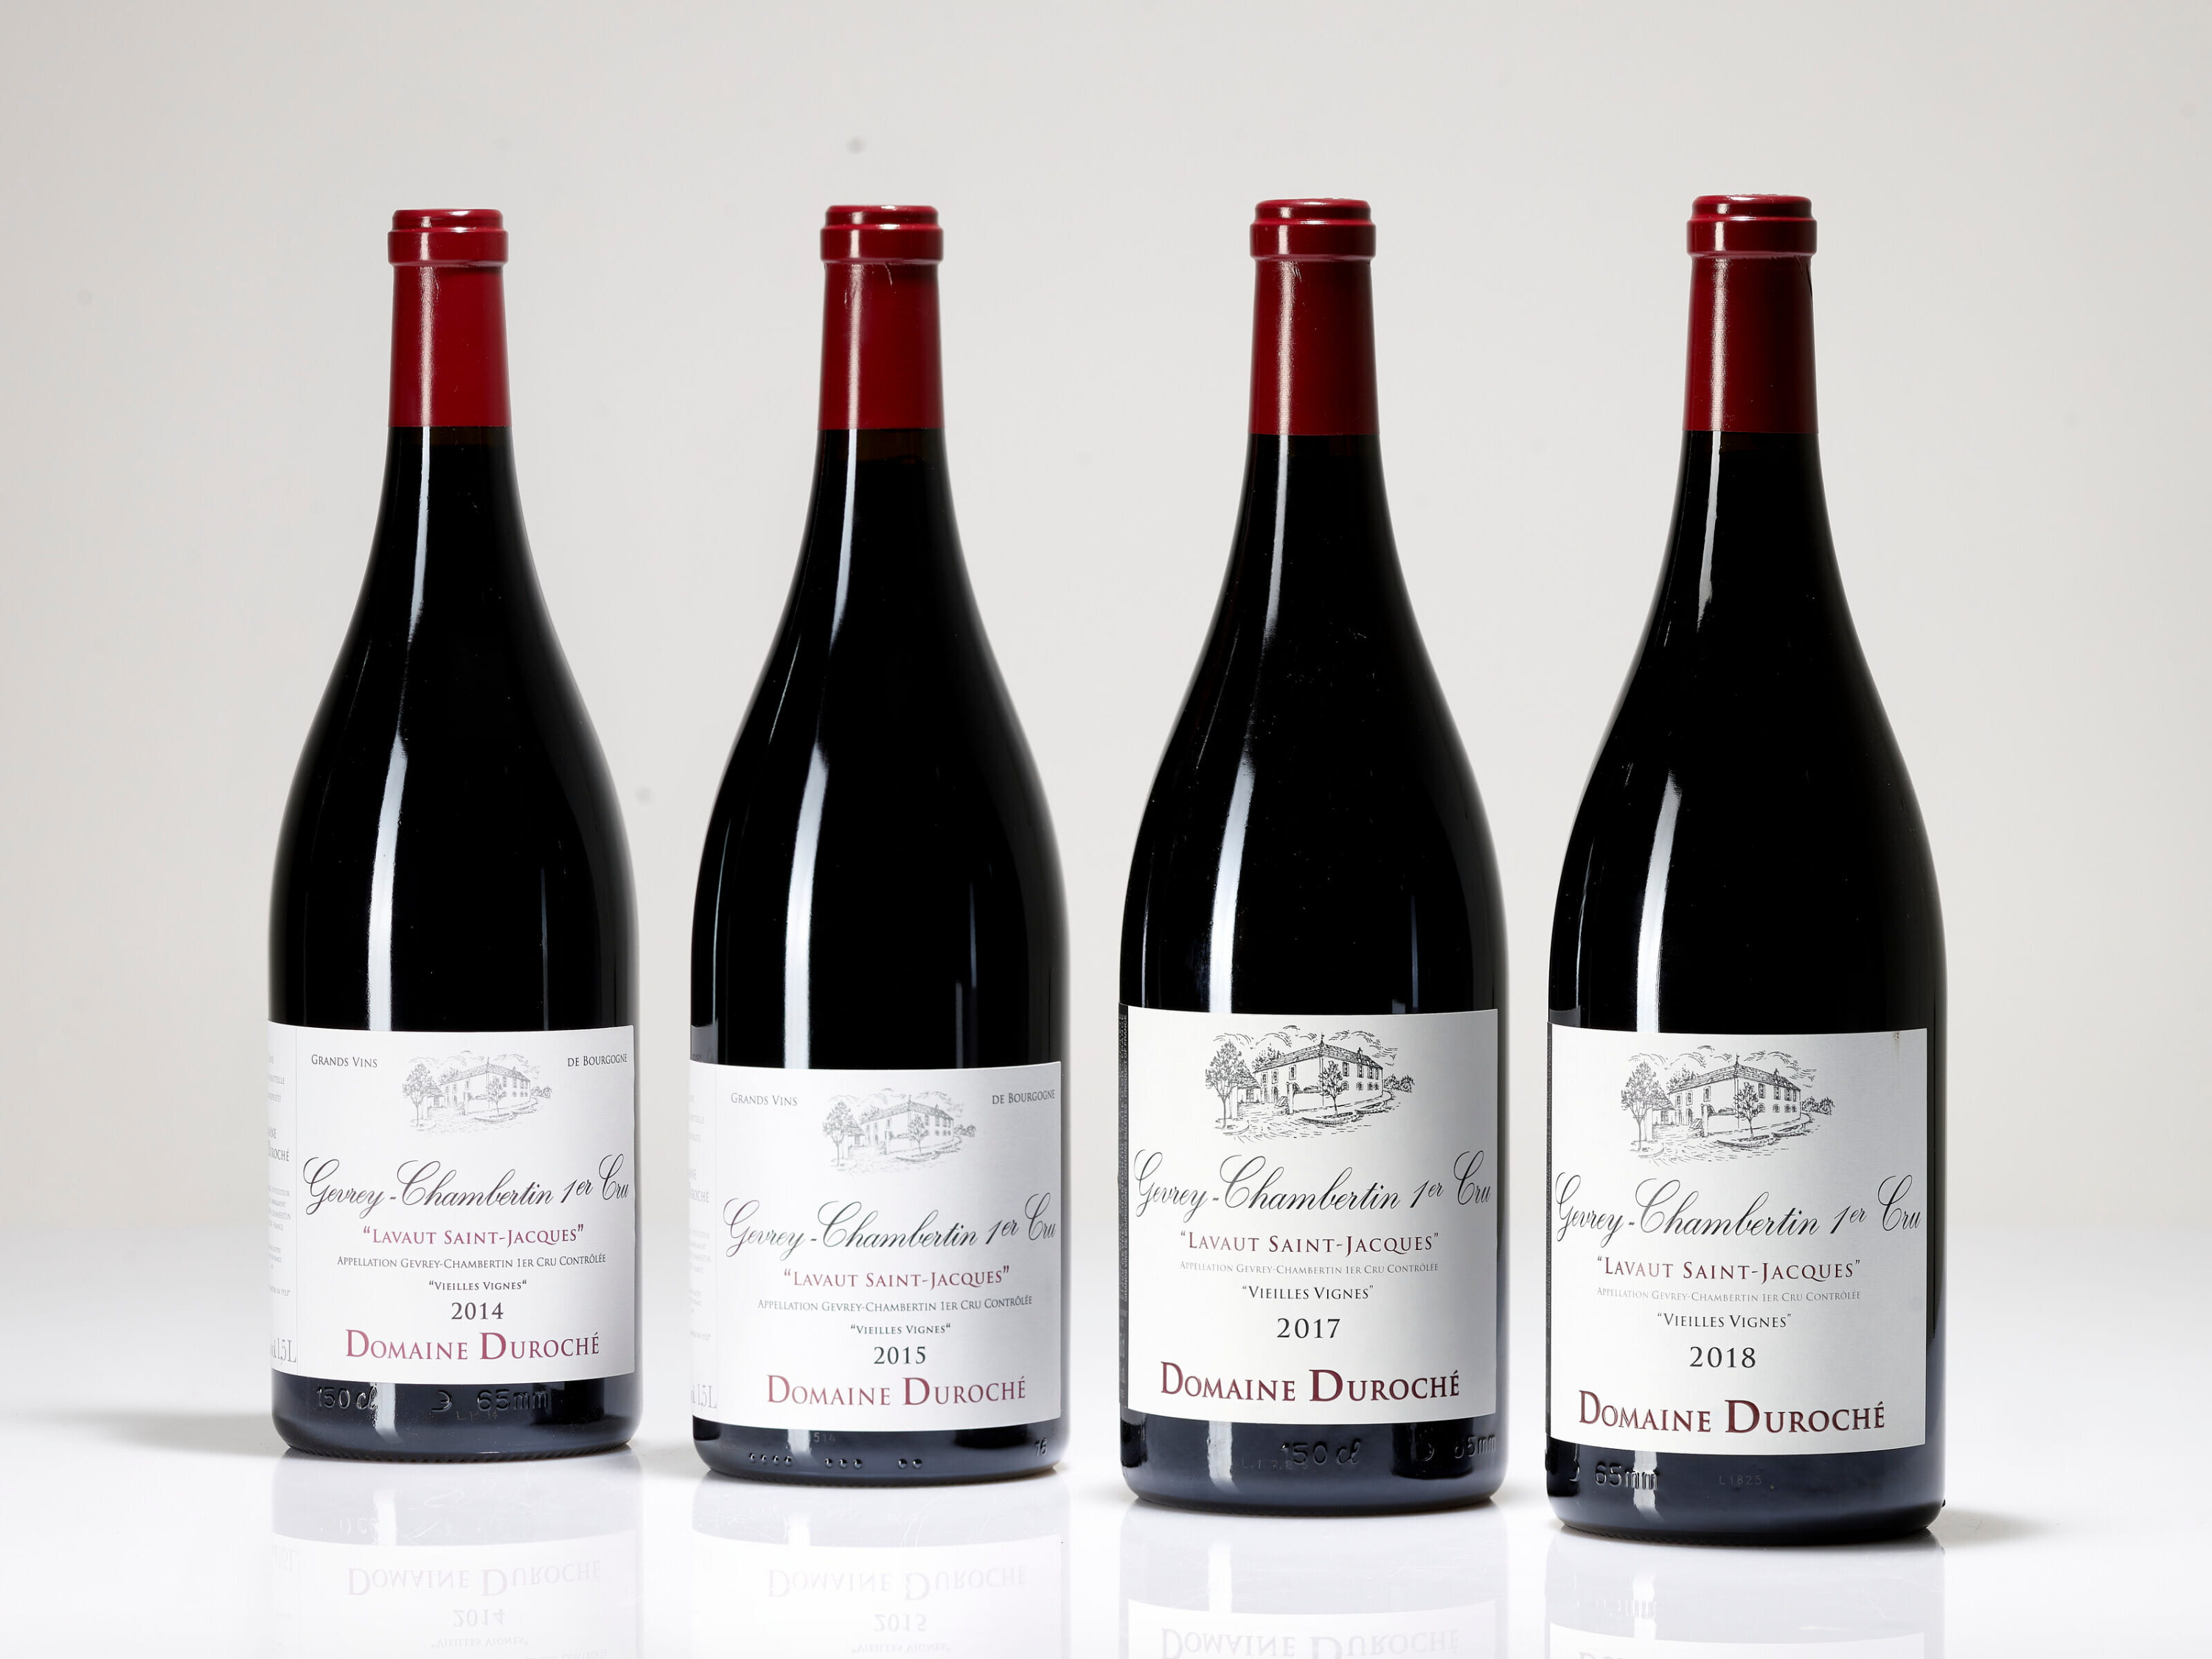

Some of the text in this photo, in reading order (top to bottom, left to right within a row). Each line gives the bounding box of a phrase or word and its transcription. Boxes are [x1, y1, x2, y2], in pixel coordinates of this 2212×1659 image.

[312, 1054, 377, 1068] GRANDS VINS
[568, 1054, 627, 1066] DE BOURGOGNE
[731, 1093, 797, 1106] GRANDS VINS
[992, 1090, 1054, 1104] DE BOURGOGNE
[560, 1180, 593, 1203] 1er
[599, 1154, 628, 1200] Cru
[1410, 1180, 1443, 1208] 1er
[1454, 1150, 1490, 1205] Cru
[1830, 1206, 1866, 1234] 1er
[1878, 1175, 1920, 1231] Cru
[985, 1220, 1019, 1245] 1er
[1025, 1192, 1055, 1240] Cru
[338, 1256, 397, 1267] APPELLATION
[401, 1259, 512, 1268] GEVREY-CHAMBERTIN
[518, 1259, 534, 1267] 1ER
[537, 1257, 556, 1267] CRU
[1180, 1261, 1233, 1272] APPELLATION
[1237, 1265, 1341, 1274] GEVREY-CHAMBERTIN
[1364, 1265, 1384, 1273] CRU
[1597, 1287, 1648, 1298] APPELLATION
[1652, 1290, 1758, 1301] GEVREY-CHAMBERTIN
[1782, 1293, 1802, 1301] CRU
[451, 1302, 504, 1320] 2014
[758, 1300, 818, 1310] APPELLATION
[822, 1302, 936, 1312] GEVREY-CHAMBERTIN
[941, 1301, 958, 1310] 1ER
[961, 1300, 981, 1310] CRU
[1277, 1318, 1340, 1338] 2017
[346, 1329, 599, 1360] DOMAINE DUROCHÉ
[874, 1346, 925, 1364] 2015
[1690, 1346, 1756, 1368] 2018
[768, 1375, 1025, 1405] DOMAINE DUROCHÉ
[1161, 1361, 1459, 1402] DOMAINE DUROCHÉ
[316, 1387, 350, 1410] 150
[477, 1388, 549, 1411] 65mm
[1579, 1390, 1885, 1433] DOMAINE DUROCHÉ
[1280, 1441, 1328, 1464] 150
[1595, 1462, 1658, 1489] 65mm
